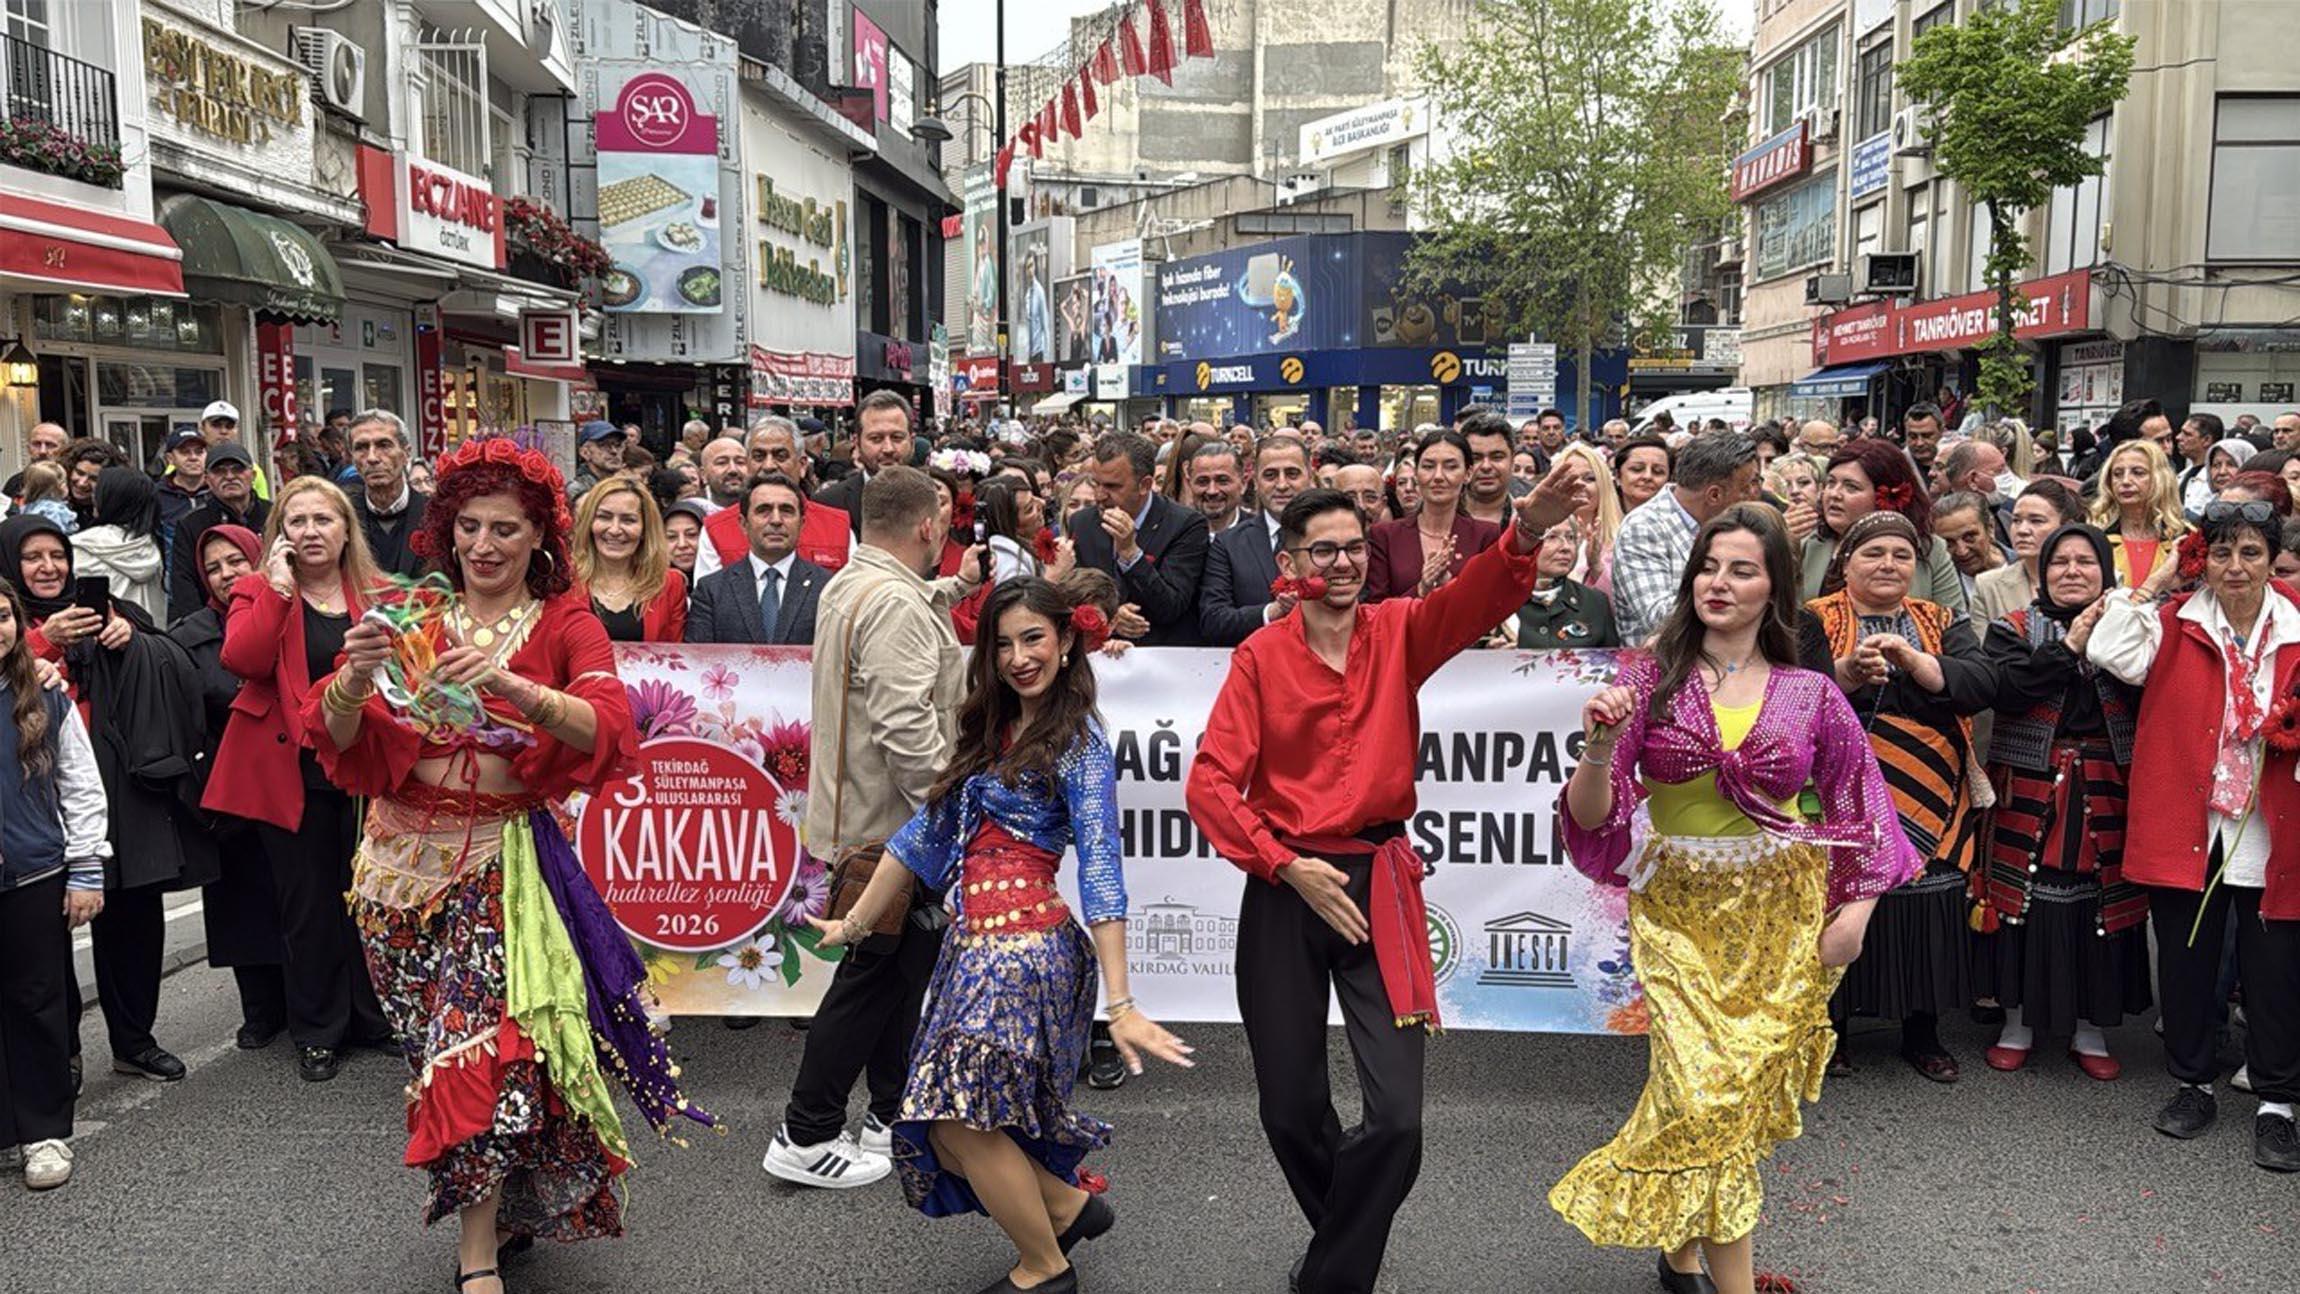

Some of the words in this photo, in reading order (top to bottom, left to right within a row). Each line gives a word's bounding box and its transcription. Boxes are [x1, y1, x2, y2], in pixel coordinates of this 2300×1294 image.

[535, 321, 562, 354] E
[1913, 307, 1985, 343] TANRIÖVER
[651, 758, 710, 774] TEKİRDAĞ
[655, 791, 742, 805] ULUSLARARASI
[604, 808, 778, 882] KAKAVA
[1413, 799, 1565, 877] ŞENLİ
[656, 913, 720, 936] 2026
[1130, 961, 1188, 975] KİRDAĞ
[1192, 962, 1232, 976] VALİL
[1490, 933, 1569, 971] UNESCO
